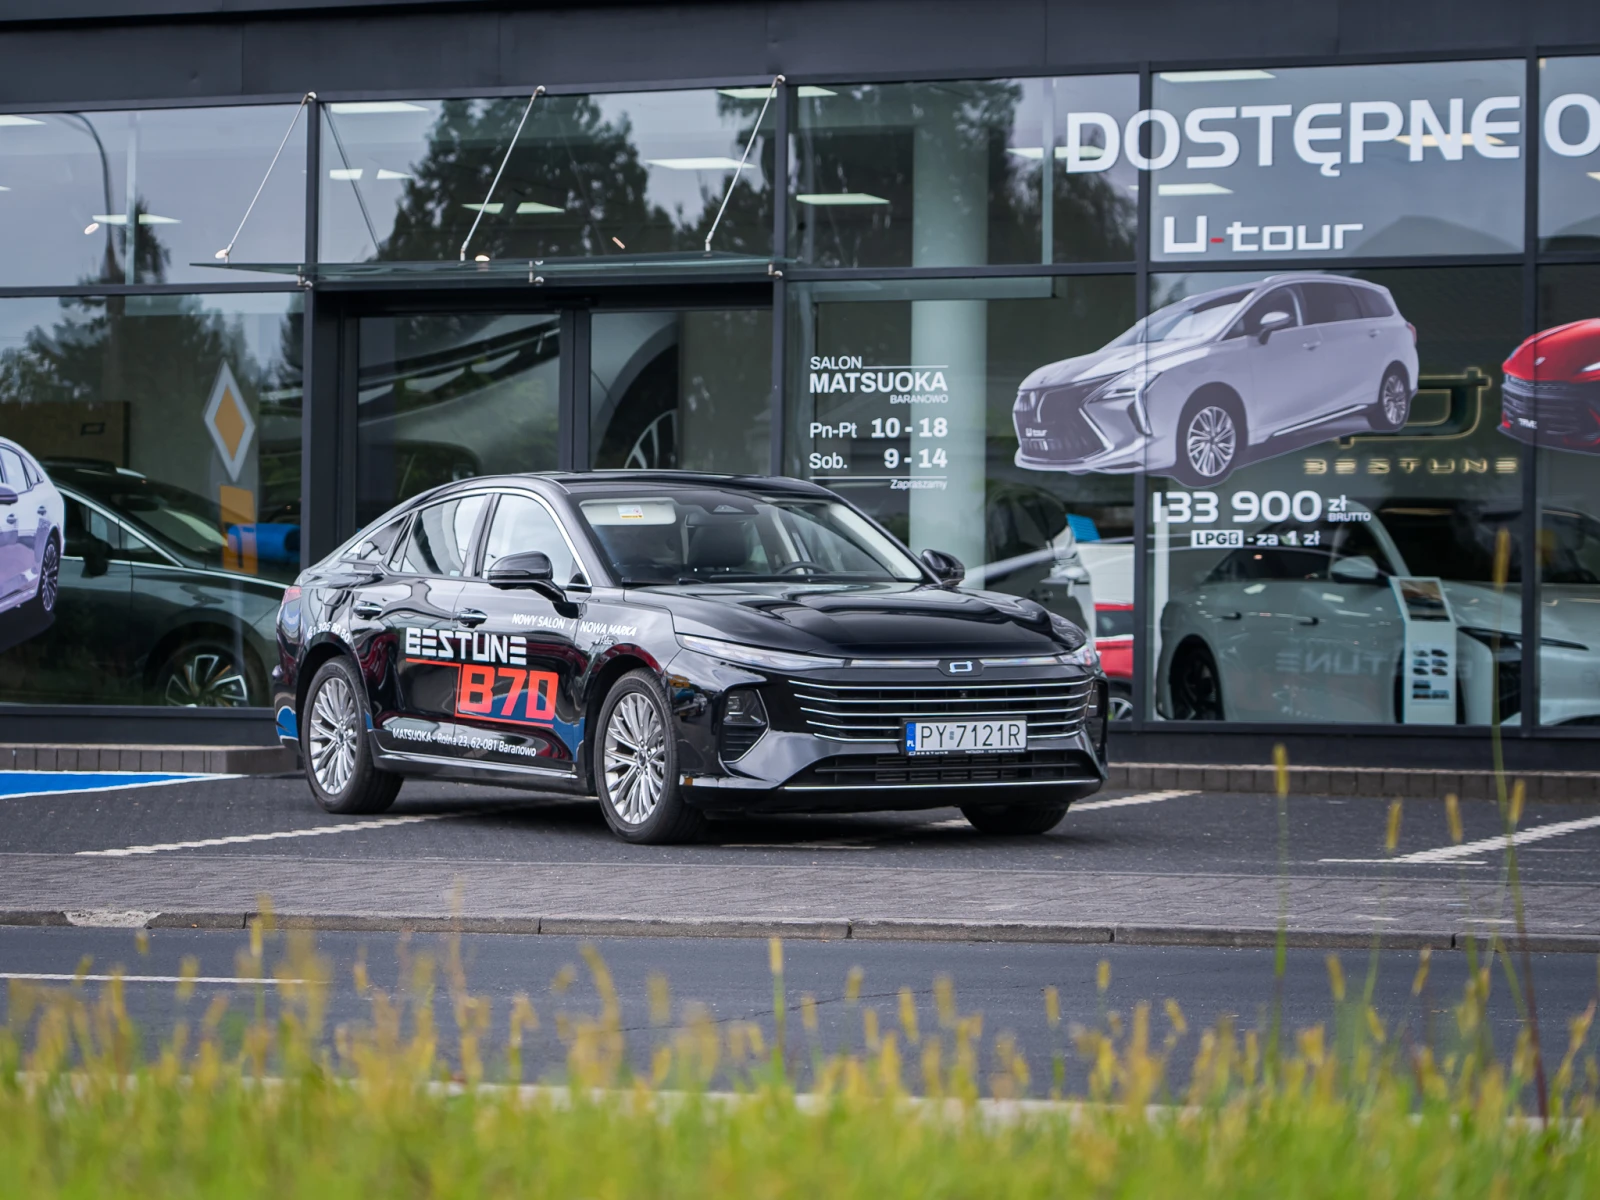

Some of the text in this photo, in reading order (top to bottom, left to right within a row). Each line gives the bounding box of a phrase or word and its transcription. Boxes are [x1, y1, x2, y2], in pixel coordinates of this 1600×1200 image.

[1066, 96, 1521, 177] DOSTĘPNE
[1163, 215, 1364, 254] U-tour
[810, 356, 863, 370] SALON
[809, 371, 949, 394] MATSUOKA
[890, 394, 949, 405] BARANOWO
[809, 422, 858, 439] Pn-Pt
[871, 417, 901, 439] 10
[918, 417, 949, 438] 18
[808, 452, 848, 469] Sob.
[883, 448, 900, 469] 9
[918, 448, 949, 469] 14
[1303, 457, 1518, 475] BESTUNE
[890, 479, 948, 491] Zapraszamy
[1152, 490, 1347, 524] 133 900 zł
[1327, 512, 1372, 522] BRUTTO
[1256, 533, 1279, 547] za
[1285, 530, 1298, 546] 1
[1303, 530, 1321, 547] zł
[331, 622, 342, 635] 80
[340, 628, 351, 643] 80
[512, 613, 538, 626] NOWY
[537, 617, 566, 630] SALON
[579, 621, 608, 634] NOWA
[606, 624, 638, 637] MARKA
[405, 627, 527, 665] BESTUNE
[458, 663, 559, 720] B70
[392, 727, 432, 743] MATSUOKA
[437, 732, 457, 746] Rolna
[458, 735, 470, 749] 23,
[470, 739, 497, 751] 62-081
[498, 740, 537, 757] Baranowo
[906, 739, 915, 748] PL
[920, 723, 1021, 749] PY 7121R
